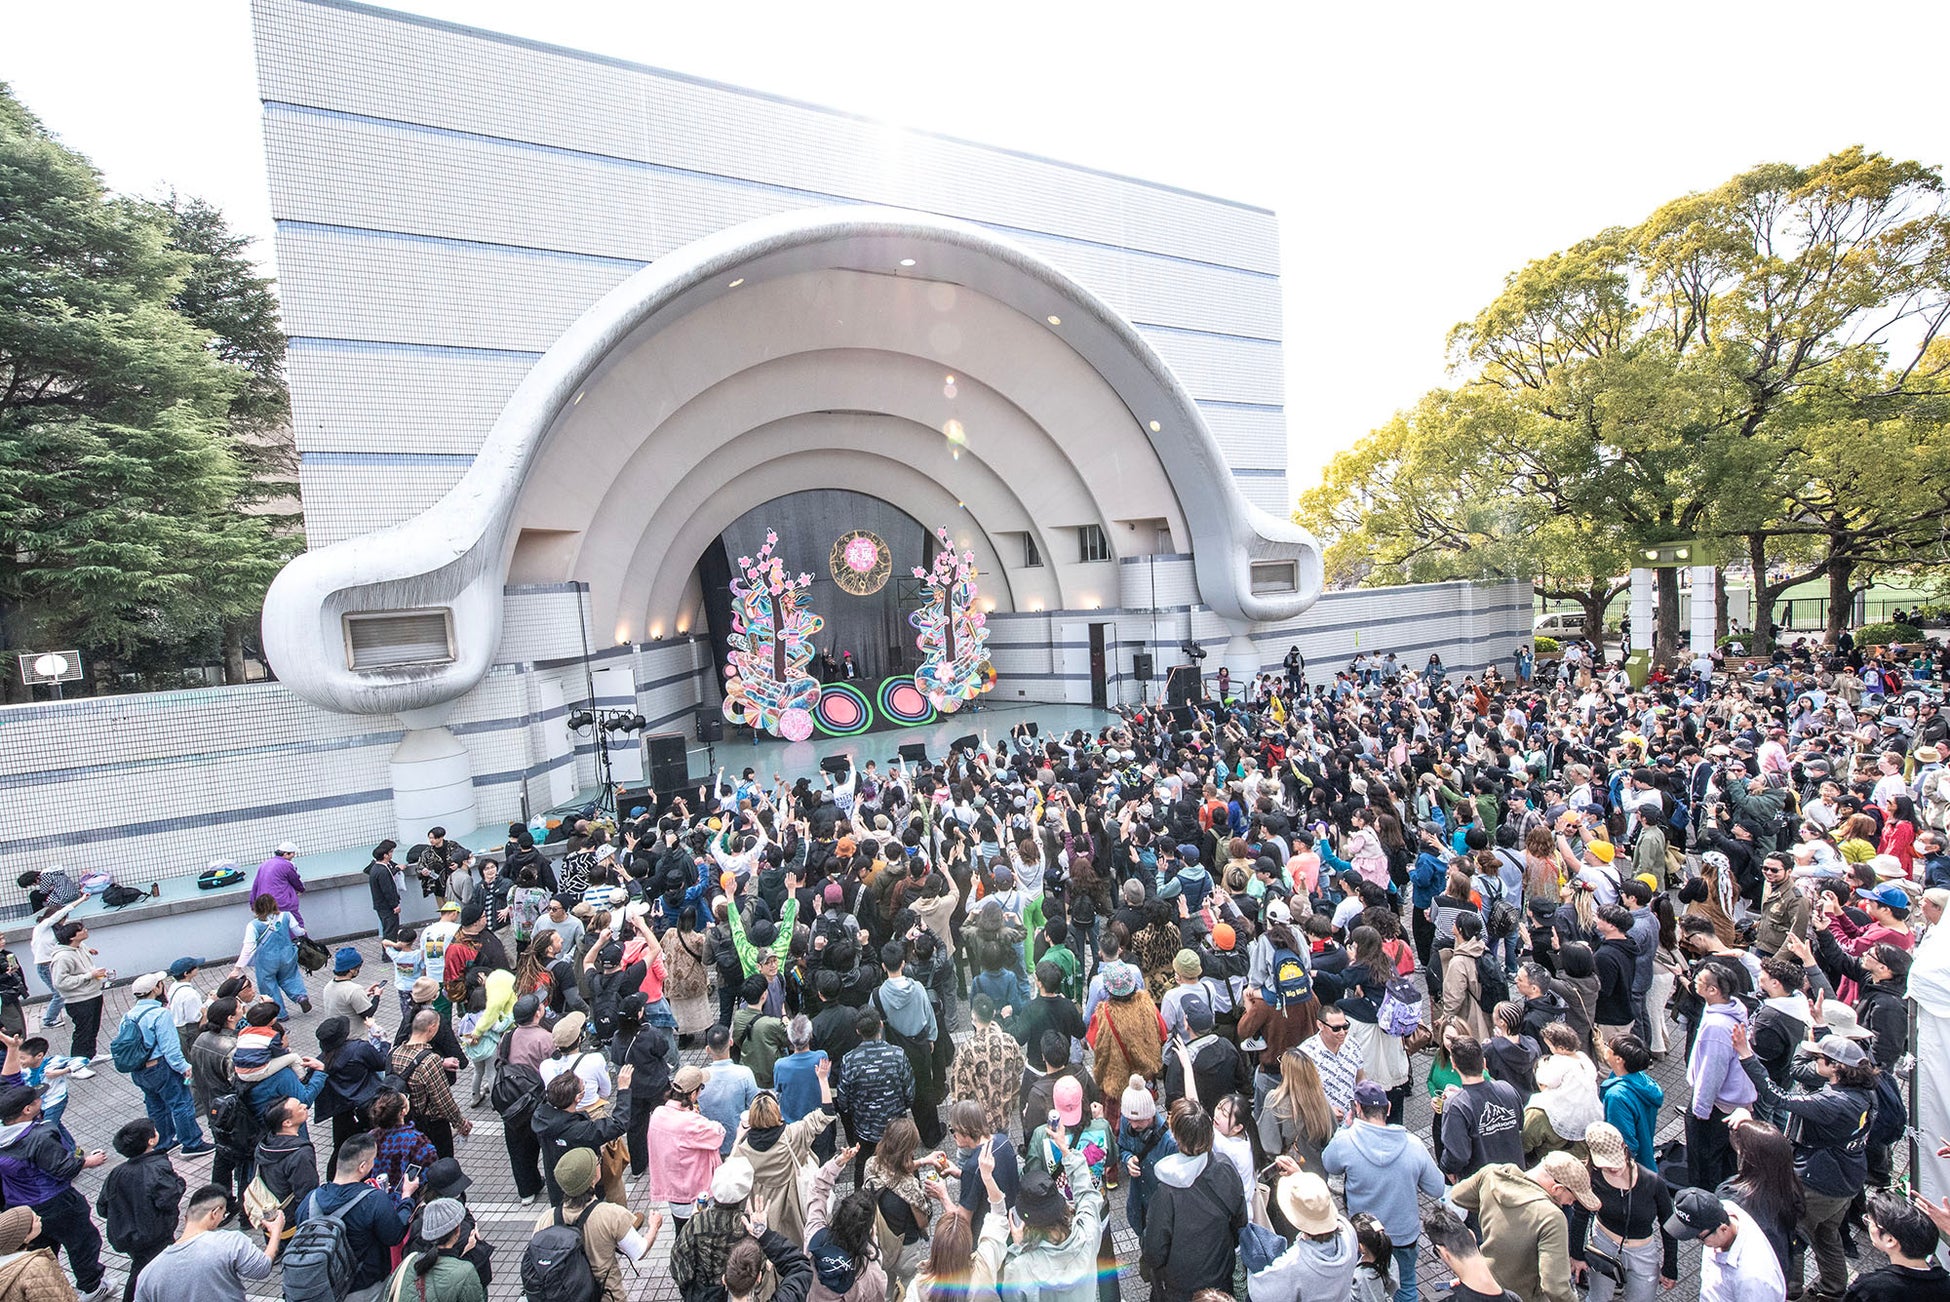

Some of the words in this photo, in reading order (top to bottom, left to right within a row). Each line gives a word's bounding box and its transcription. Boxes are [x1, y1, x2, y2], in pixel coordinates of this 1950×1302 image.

[850, 544, 874, 562] 春風
[1285, 990, 1296, 998] Big
[1296, 986, 1308, 995] Bird
